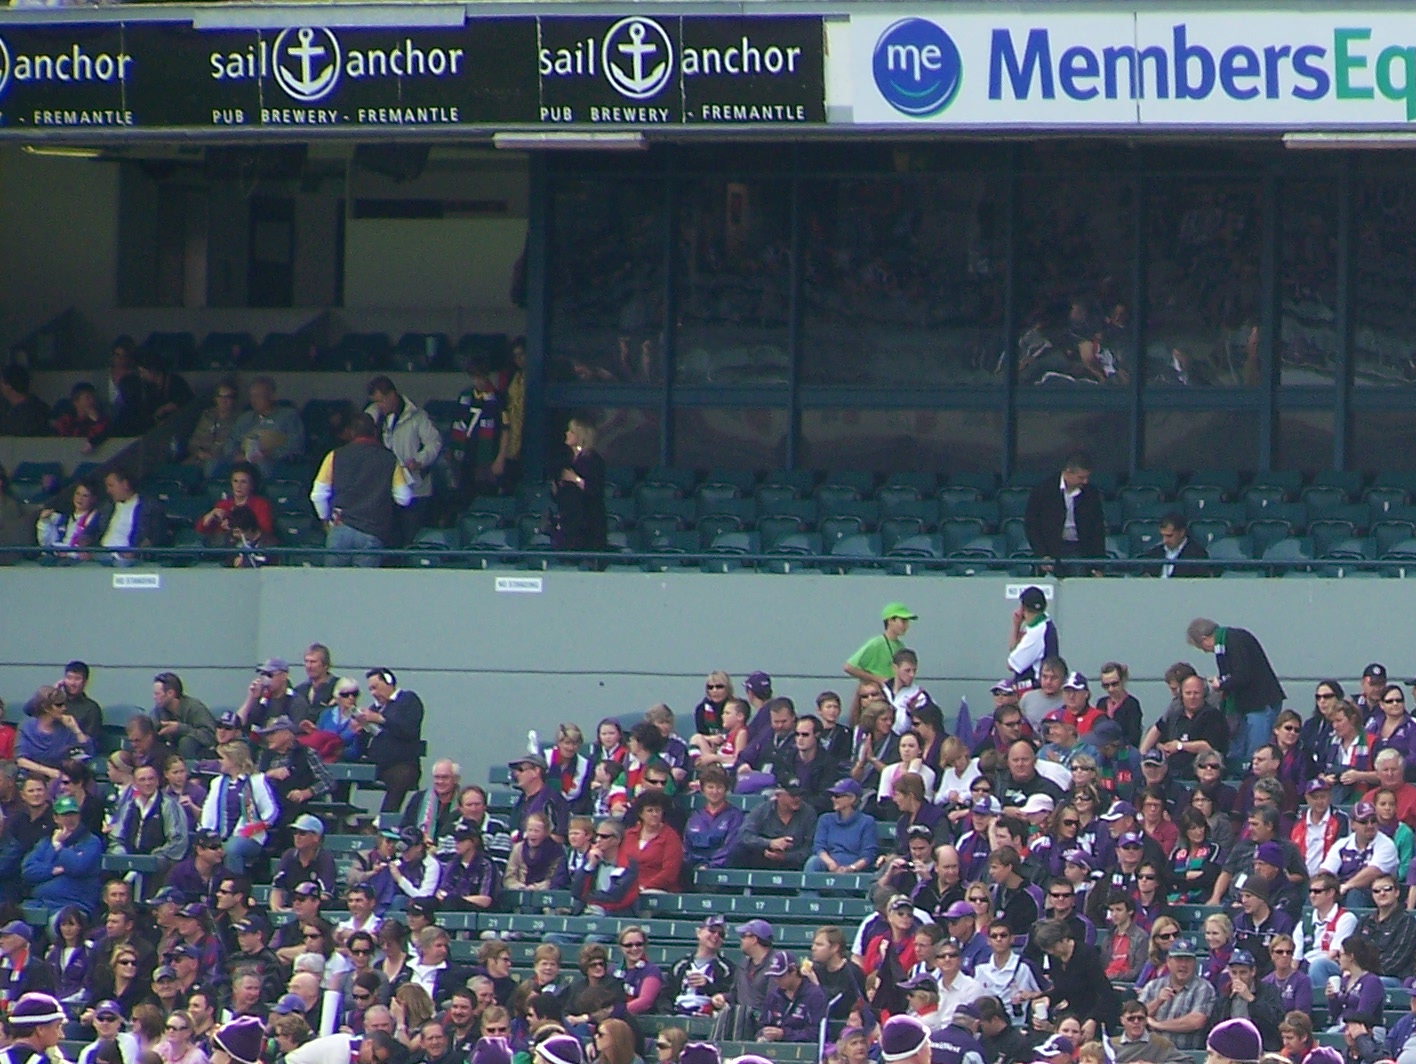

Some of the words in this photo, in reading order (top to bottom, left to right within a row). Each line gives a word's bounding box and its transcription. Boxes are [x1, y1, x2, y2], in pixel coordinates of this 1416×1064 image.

[14, 44, 132, 80] anchor
[211, 41, 266, 79] sail
[346, 39, 464, 77] anchor
[540, 38, 594, 75] sail
[683, 36, 801, 74] anchor
[888, 42, 942, 82] me
[34, 111, 133, 126] FREMANTLE
[213, 110, 244, 124] PUB
[262, 110, 338, 124] BREWERY
[358, 108, 459, 124] FREMANTLE
[540, 107, 572, 122] PUB
[590, 107, 669, 122] BREWERY
[702, 105, 805, 121] FREMANTLE
[466, 407, 482, 437] 7
